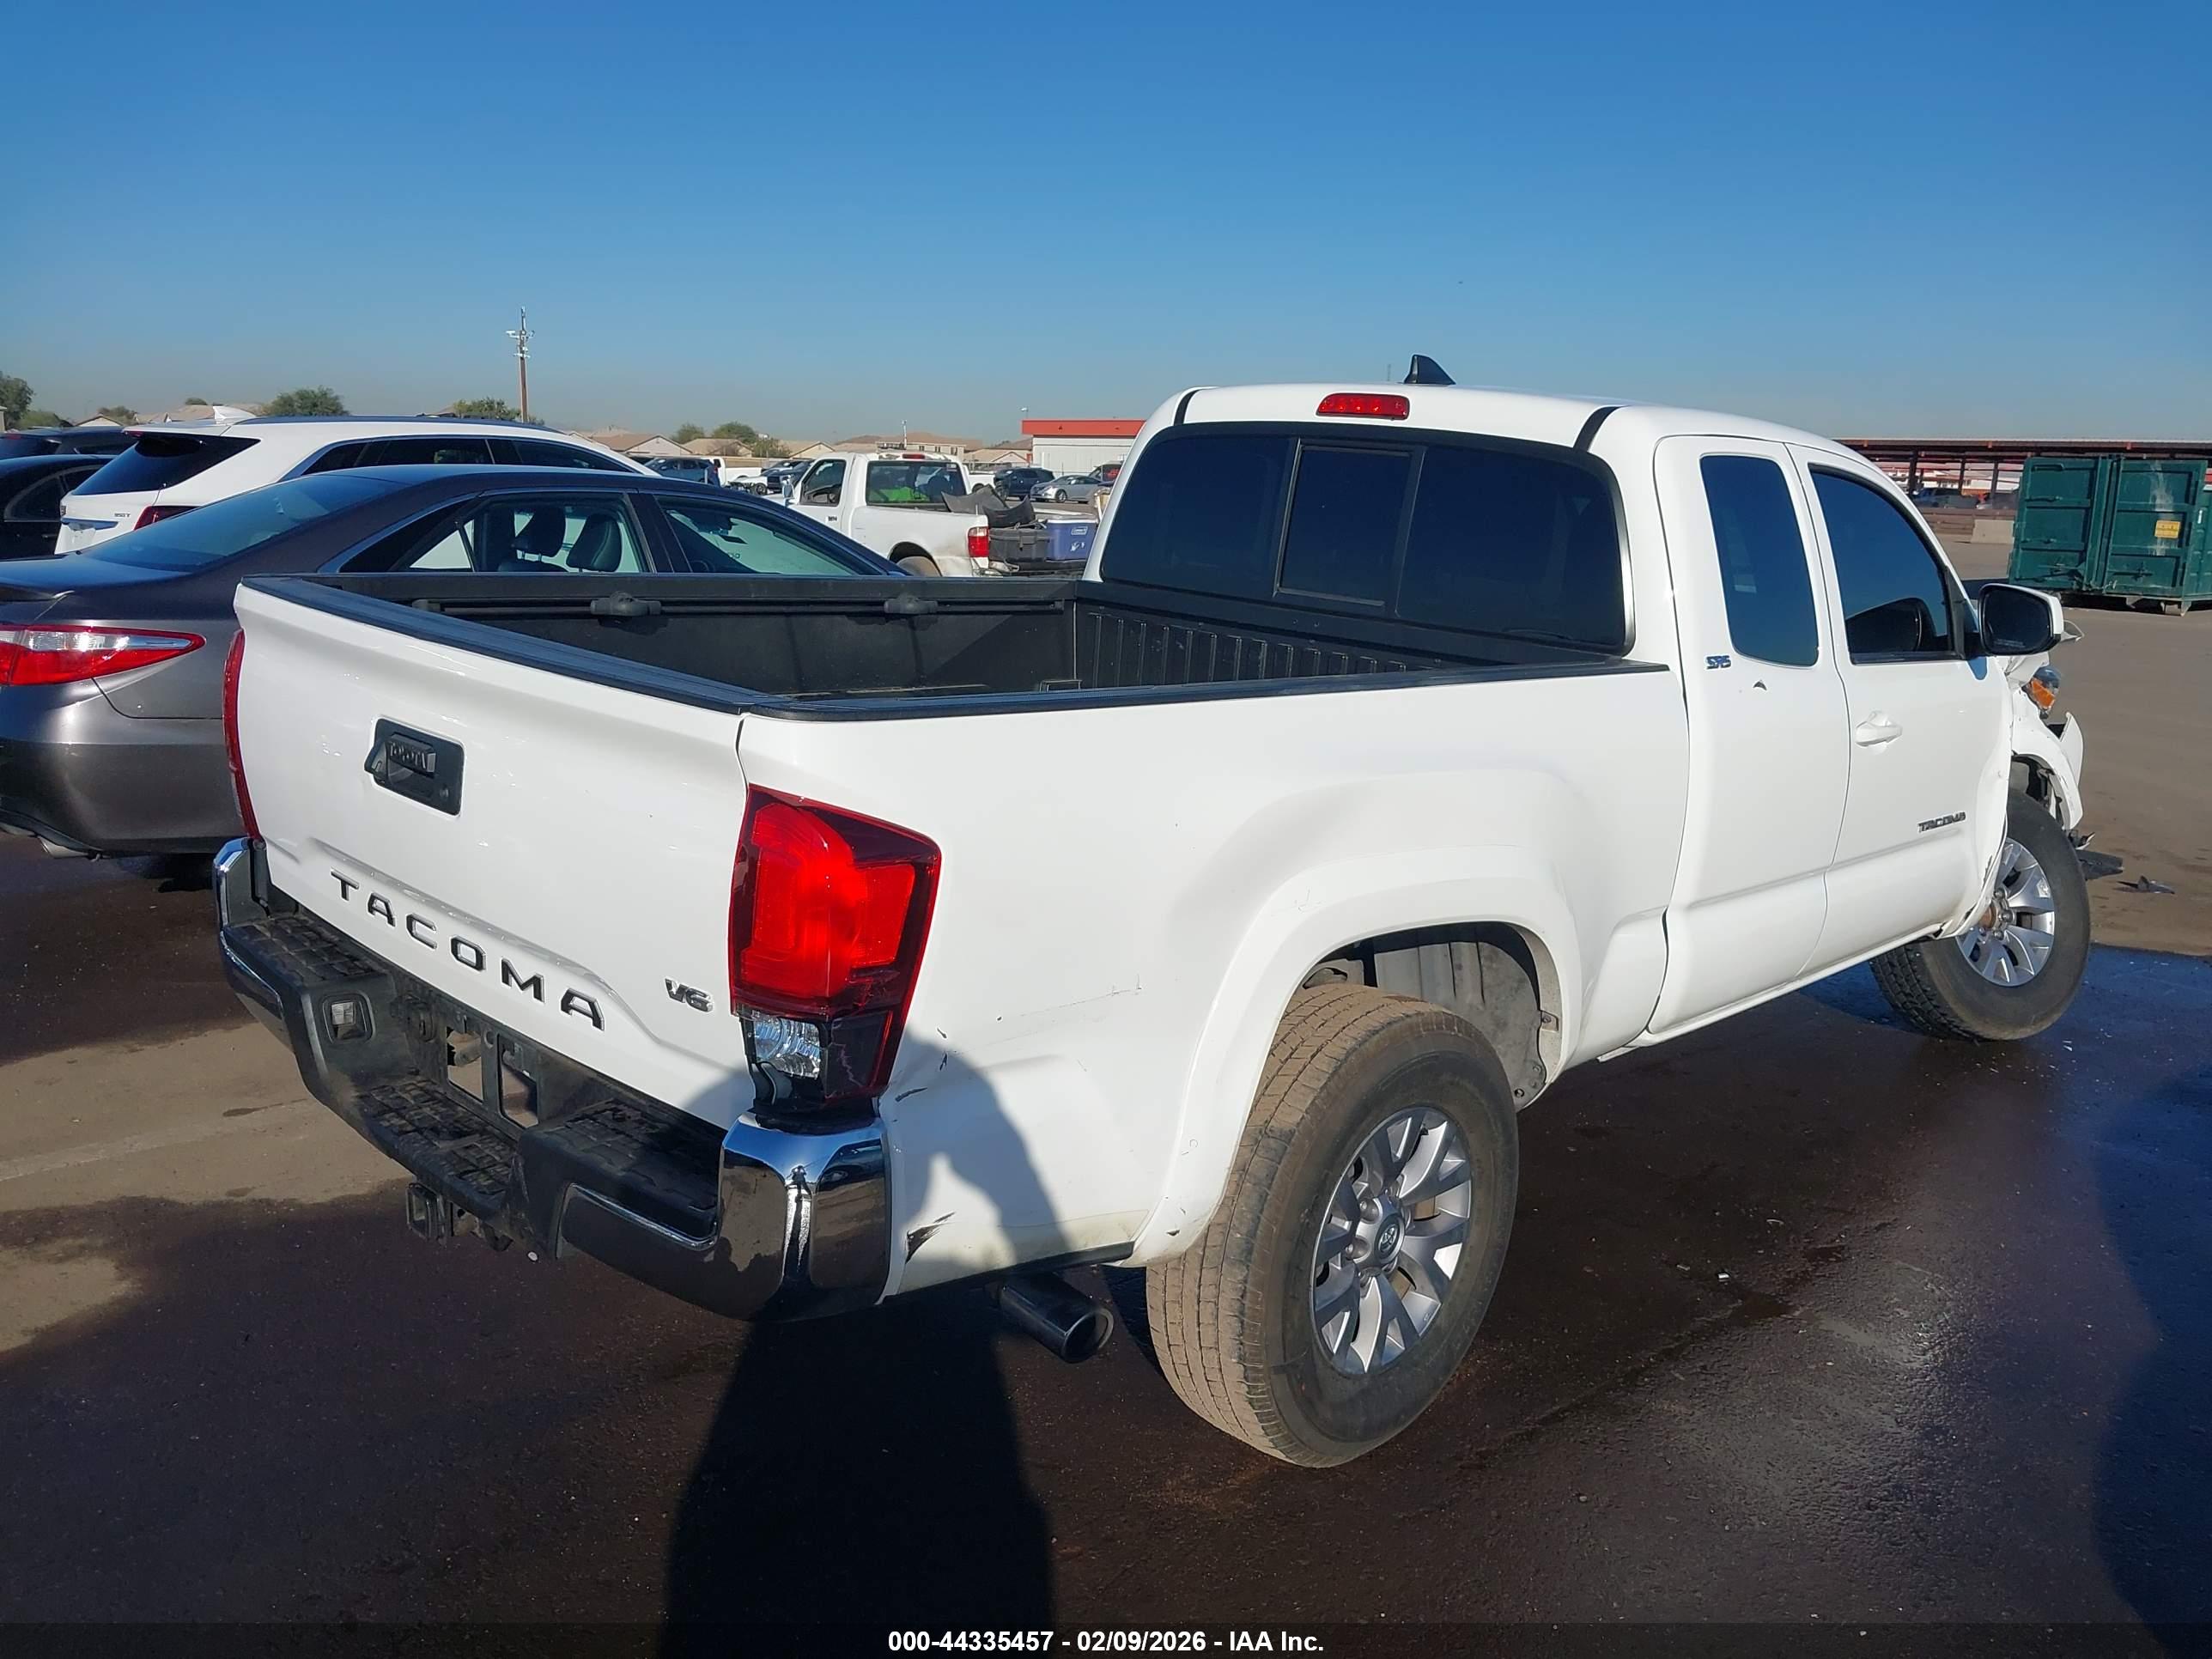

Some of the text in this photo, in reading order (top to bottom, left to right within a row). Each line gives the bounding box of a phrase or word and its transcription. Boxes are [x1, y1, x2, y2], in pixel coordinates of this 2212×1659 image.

[1917, 811, 1967, 833] TACOMA
[330, 869, 606, 1031] TACOMA
[664, 977, 714, 1013] V6
